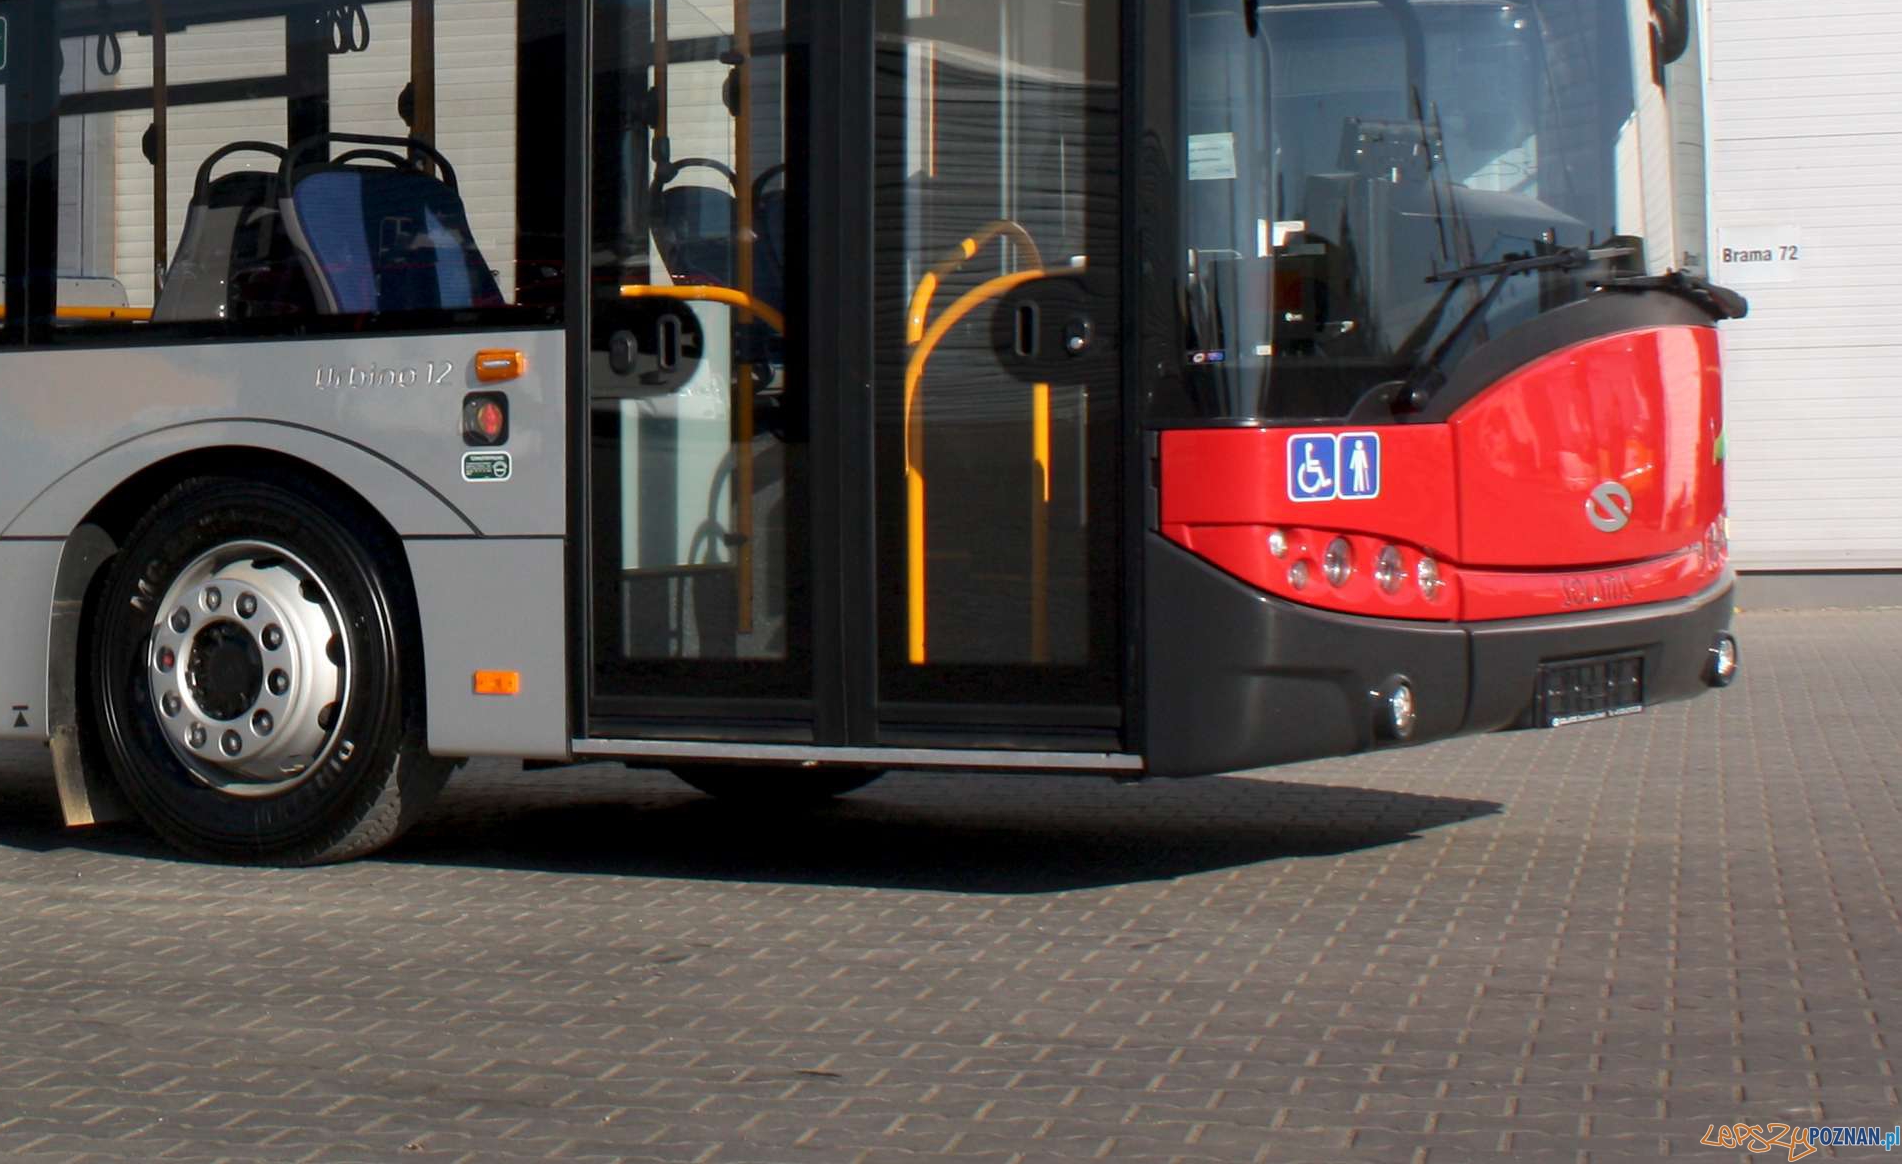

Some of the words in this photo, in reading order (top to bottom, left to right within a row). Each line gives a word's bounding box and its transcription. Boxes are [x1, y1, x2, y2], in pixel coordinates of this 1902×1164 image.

[1722, 247, 1772, 263] Brama
[1779, 245, 1798, 261] 72
[426, 361, 453, 384] 12
